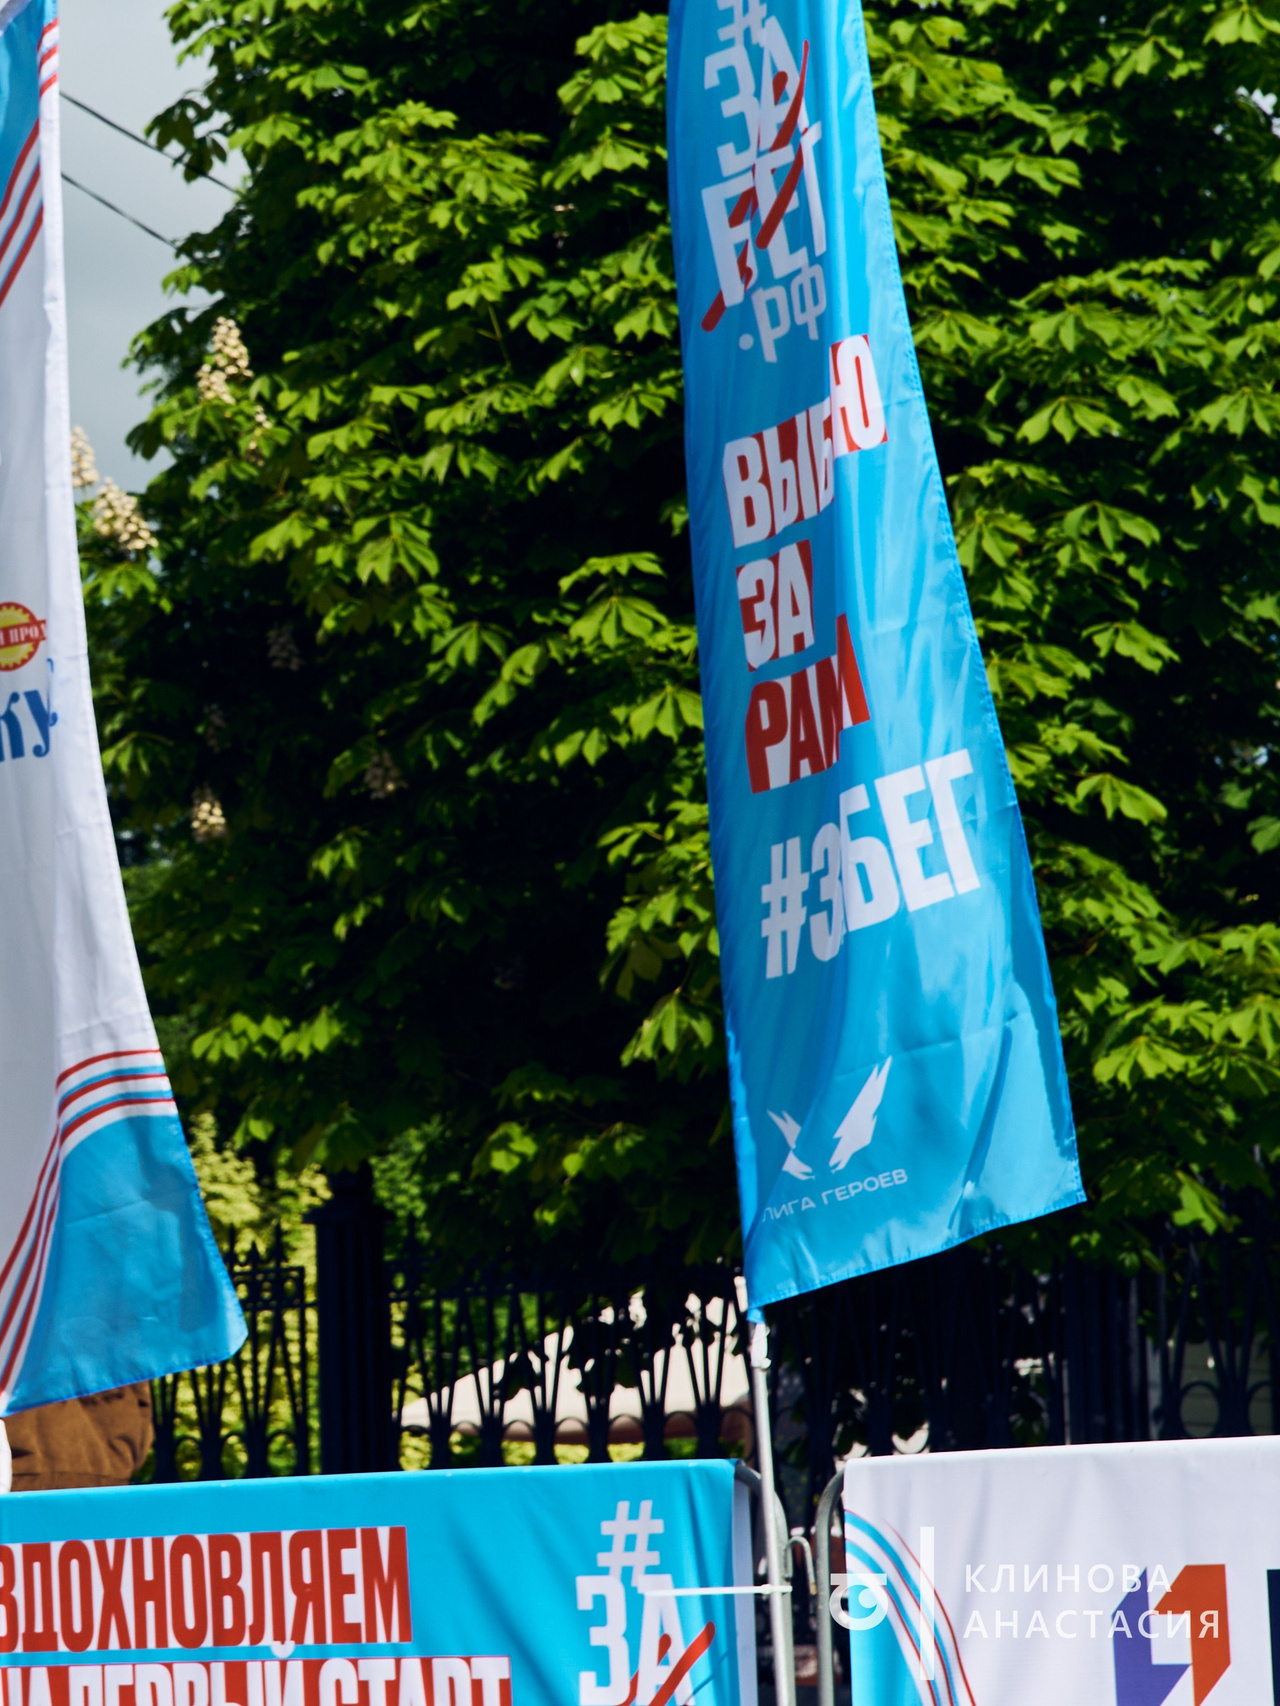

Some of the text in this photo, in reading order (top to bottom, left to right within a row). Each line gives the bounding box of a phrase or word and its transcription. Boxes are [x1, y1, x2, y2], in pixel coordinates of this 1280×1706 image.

[735, 540, 815, 672] ЗА
[745, 612, 871, 794] РАМ
[761, 748, 981, 979] #ЗБЕГ
[762, 1168, 909, 1223] ЛИГА ГЕРОЕВ
